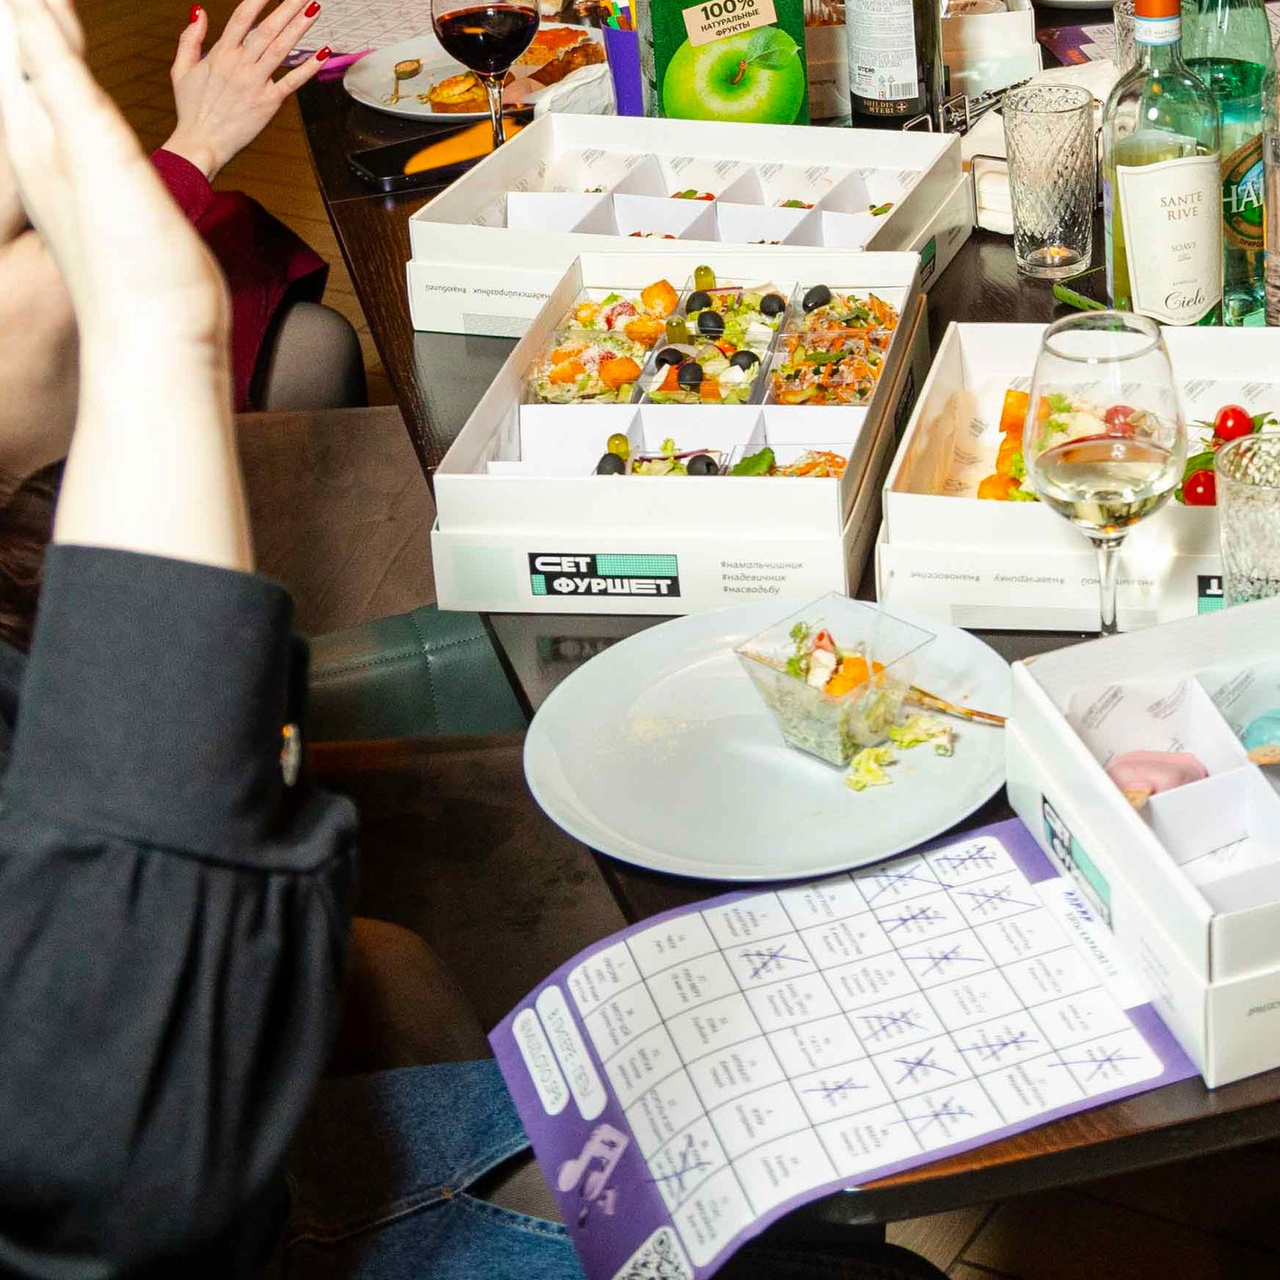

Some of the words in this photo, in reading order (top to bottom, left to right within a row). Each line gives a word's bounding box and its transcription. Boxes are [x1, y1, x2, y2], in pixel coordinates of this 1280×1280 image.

[701, 8, 760, 32] НАТУРАЛЬНЫЕ
[715, 21, 751, 37] ФРУКТЫ
[1160, 191, 1203, 208] SANTE
[1167, 207, 1199, 221] RIVE
[472, 287, 551, 299] надетскийпраздник
[1164, 287, 1206, 310] Cielo
[534, 556, 591, 573] СЕТ
[720, 560, 804, 571] #намальчишник
[722, 572, 787, 583] #надевичник
[552, 577, 672, 595] ФУРШЕТ
[722, 584, 780, 595] #насвадьбу
